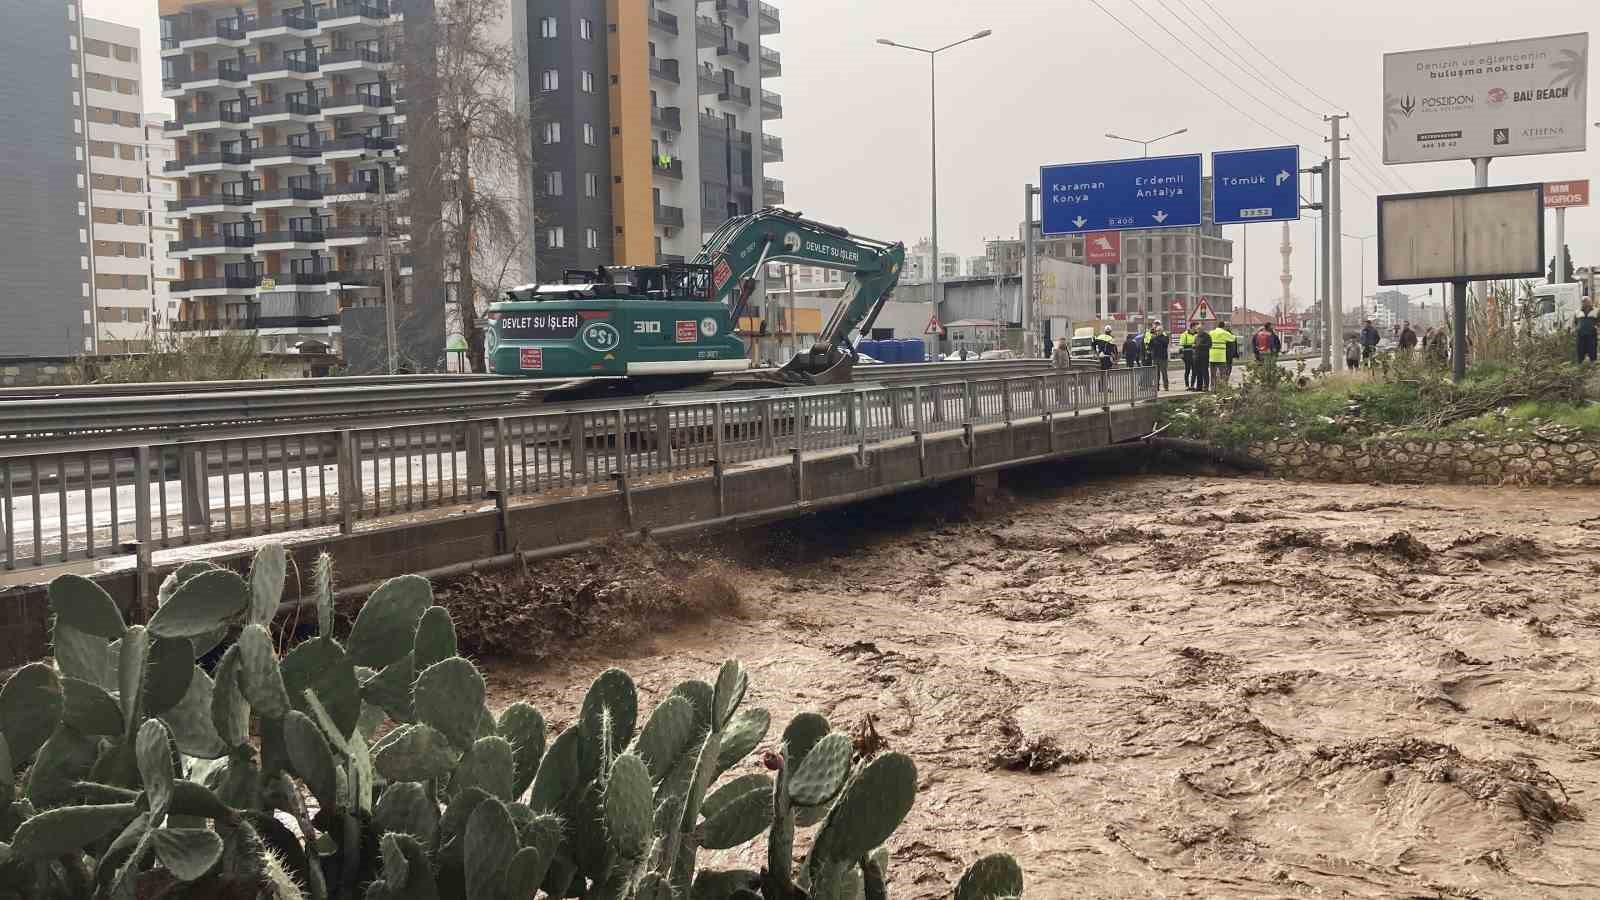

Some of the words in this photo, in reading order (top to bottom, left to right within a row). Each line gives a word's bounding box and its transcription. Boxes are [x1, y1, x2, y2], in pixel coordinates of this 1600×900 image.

[1536, 87, 1569, 101] BEACH
[1422, 95, 1474, 107] POSEIDON
[1135, 174, 1184, 186] Erdemli
[1053, 181, 1105, 192] Karaman
[1551, 184, 1569, 193] MM
[1052, 193, 1089, 204] Konya
[1136, 187, 1184, 199] Antalya
[806, 240, 830, 256] DEVLET
[830, 247, 839, 257] SU
[840, 247, 859, 262] İŞLERİ
[502, 317, 532, 329] DEVLET
[534, 316, 546, 328] SU
[547, 313, 578, 331] İŞLERİ
[633, 320, 661, 333] 310
